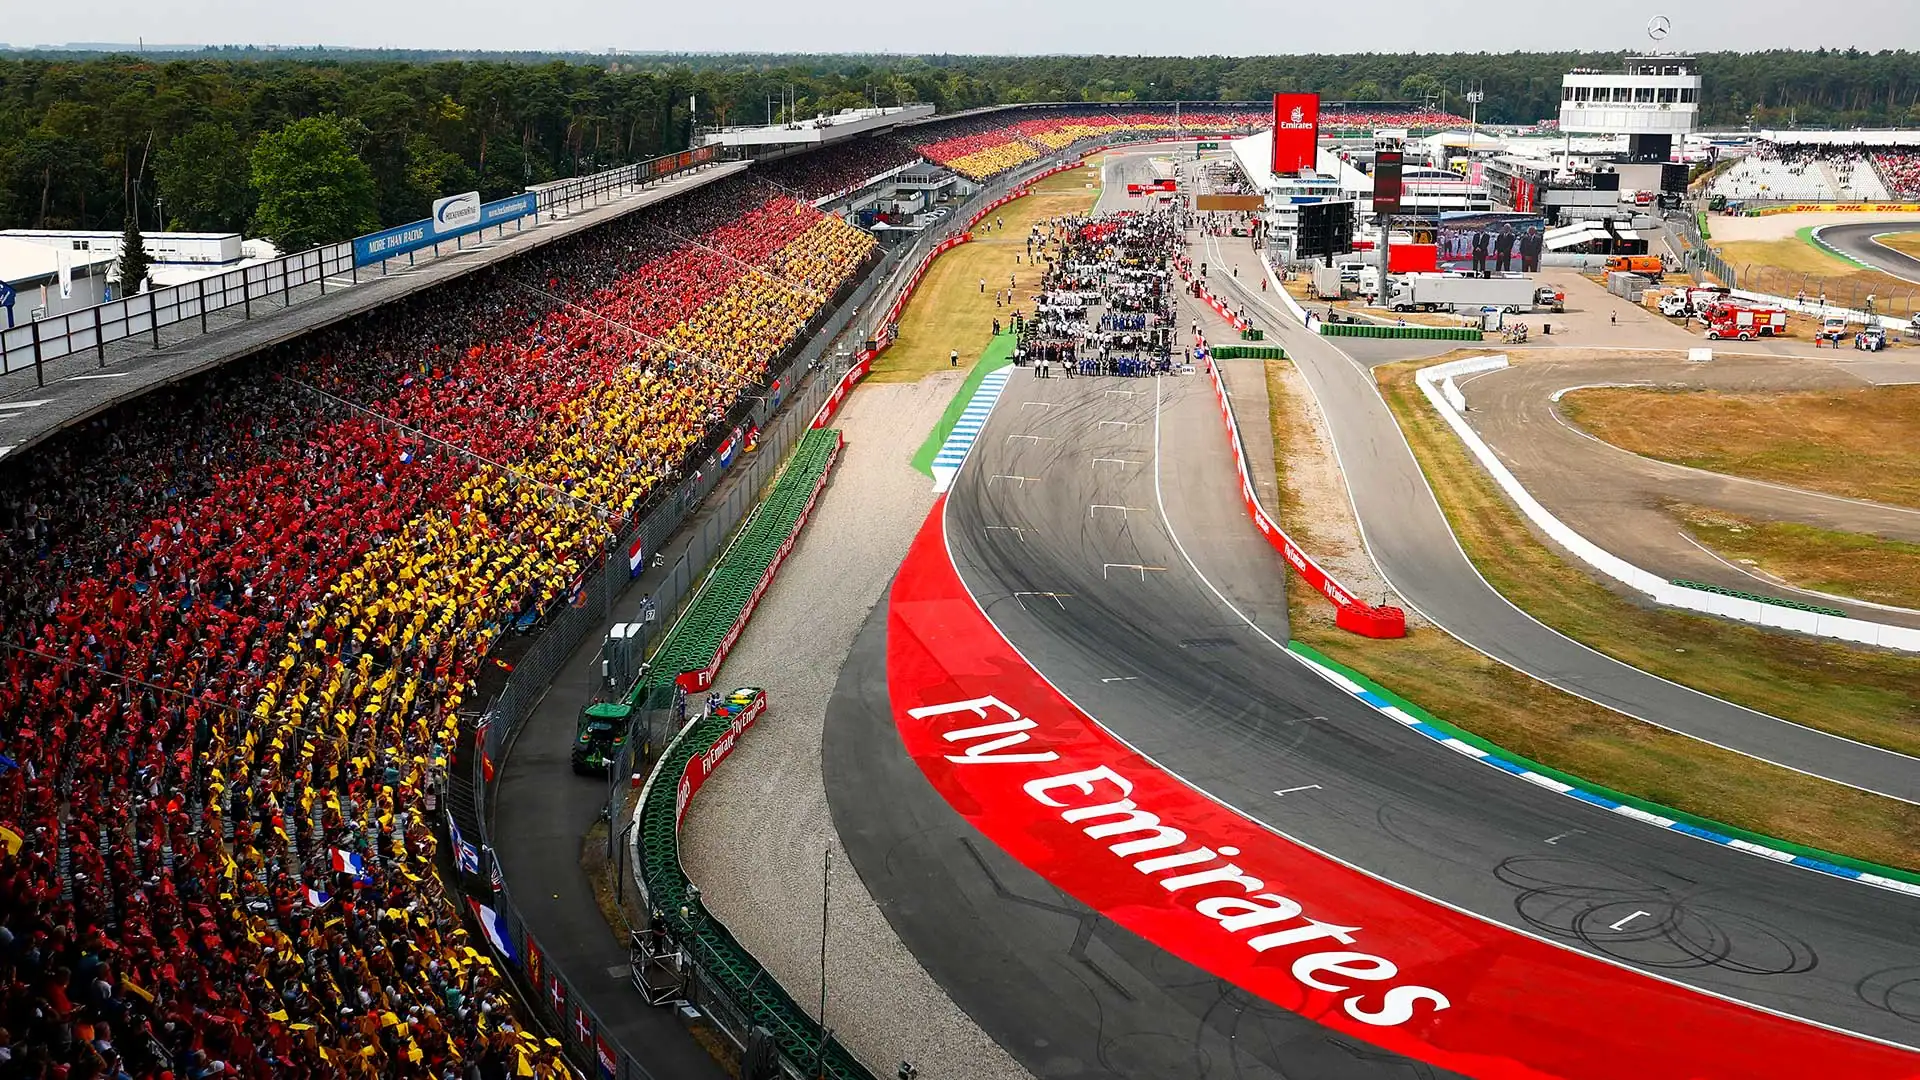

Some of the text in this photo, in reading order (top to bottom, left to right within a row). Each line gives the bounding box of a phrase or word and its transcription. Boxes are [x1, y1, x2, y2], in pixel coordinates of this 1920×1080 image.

[1281, 121, 1313, 130] Emirates
[369, 228, 424, 254] MORE THAN RACING
[907, 694, 1451, 1026] Fly Emirates
